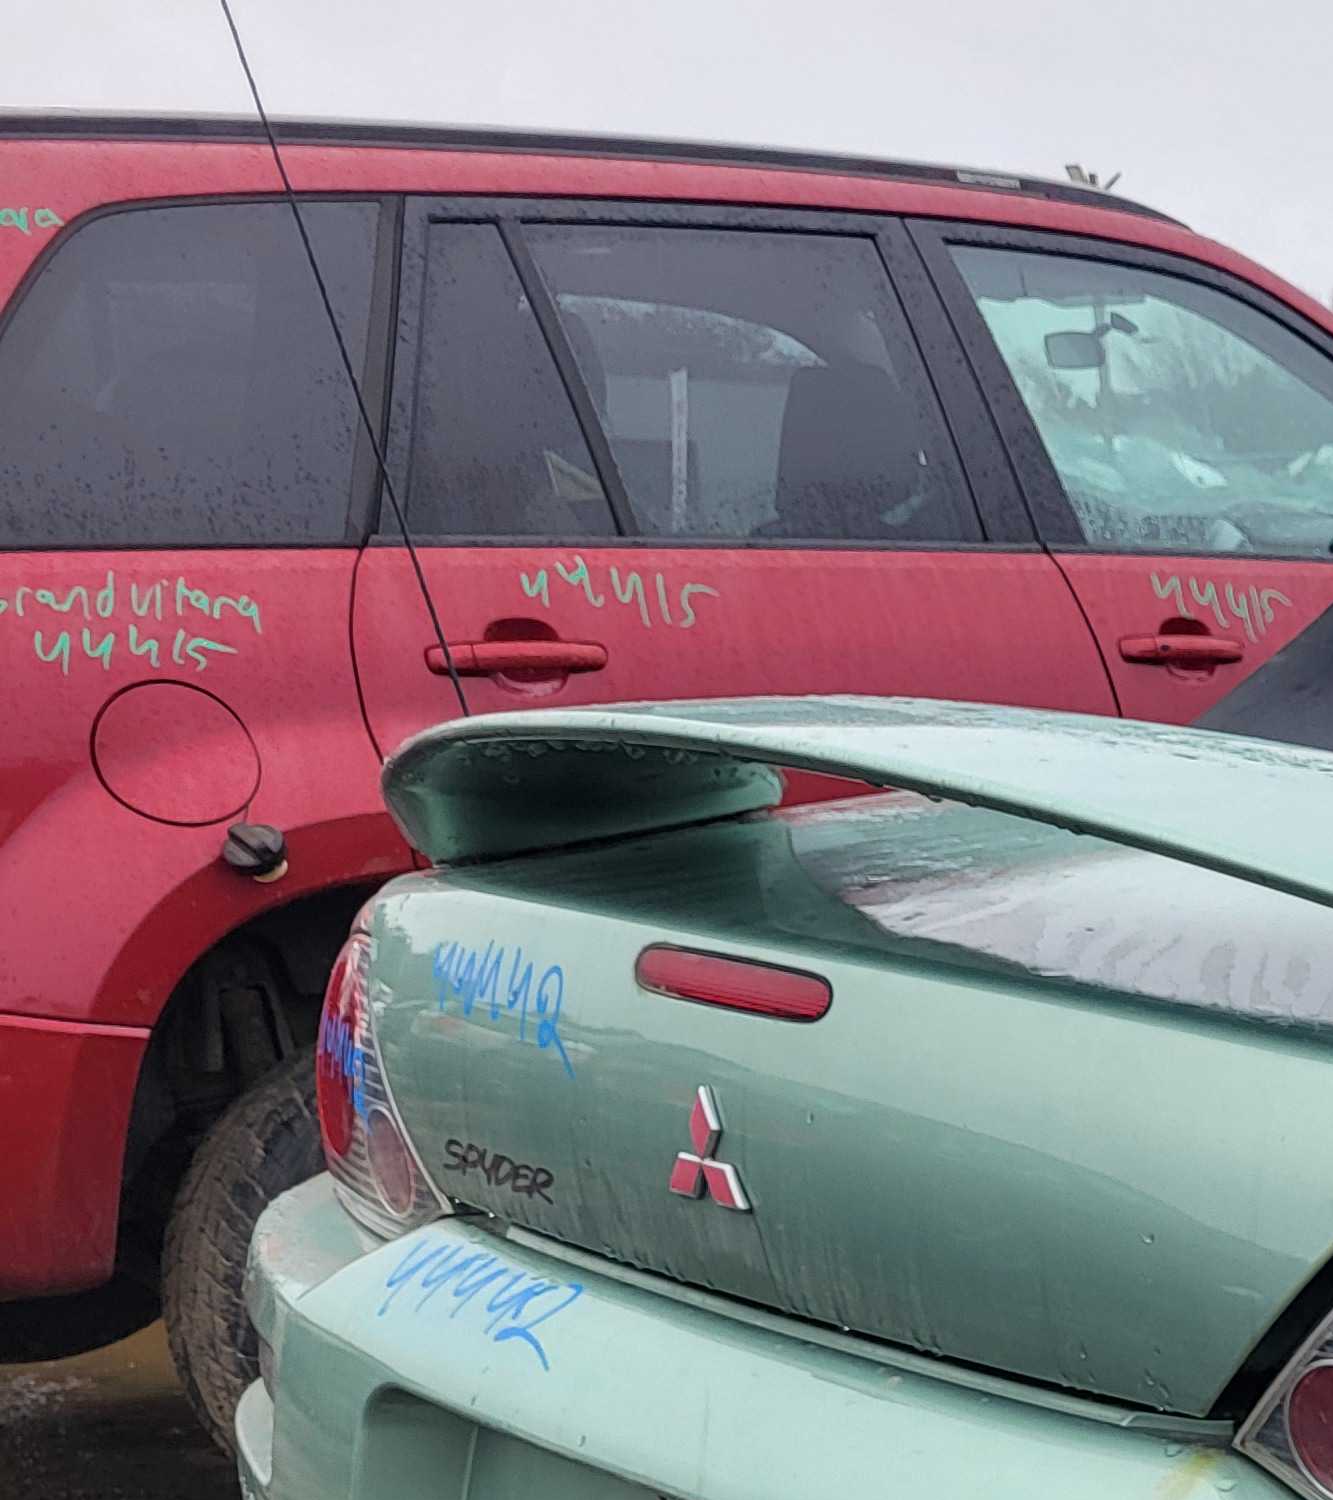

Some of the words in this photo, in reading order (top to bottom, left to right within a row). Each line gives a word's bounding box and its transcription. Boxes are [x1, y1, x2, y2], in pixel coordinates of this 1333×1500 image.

[520, 554, 721, 628] 44415
[1150, 571, 1294, 644] 44415
[34, 623, 239, 676] 44415
[432, 938, 576, 1081] 44442
[444, 1138, 556, 1205] SPYDER
[377, 1238, 584, 1372] 44442
